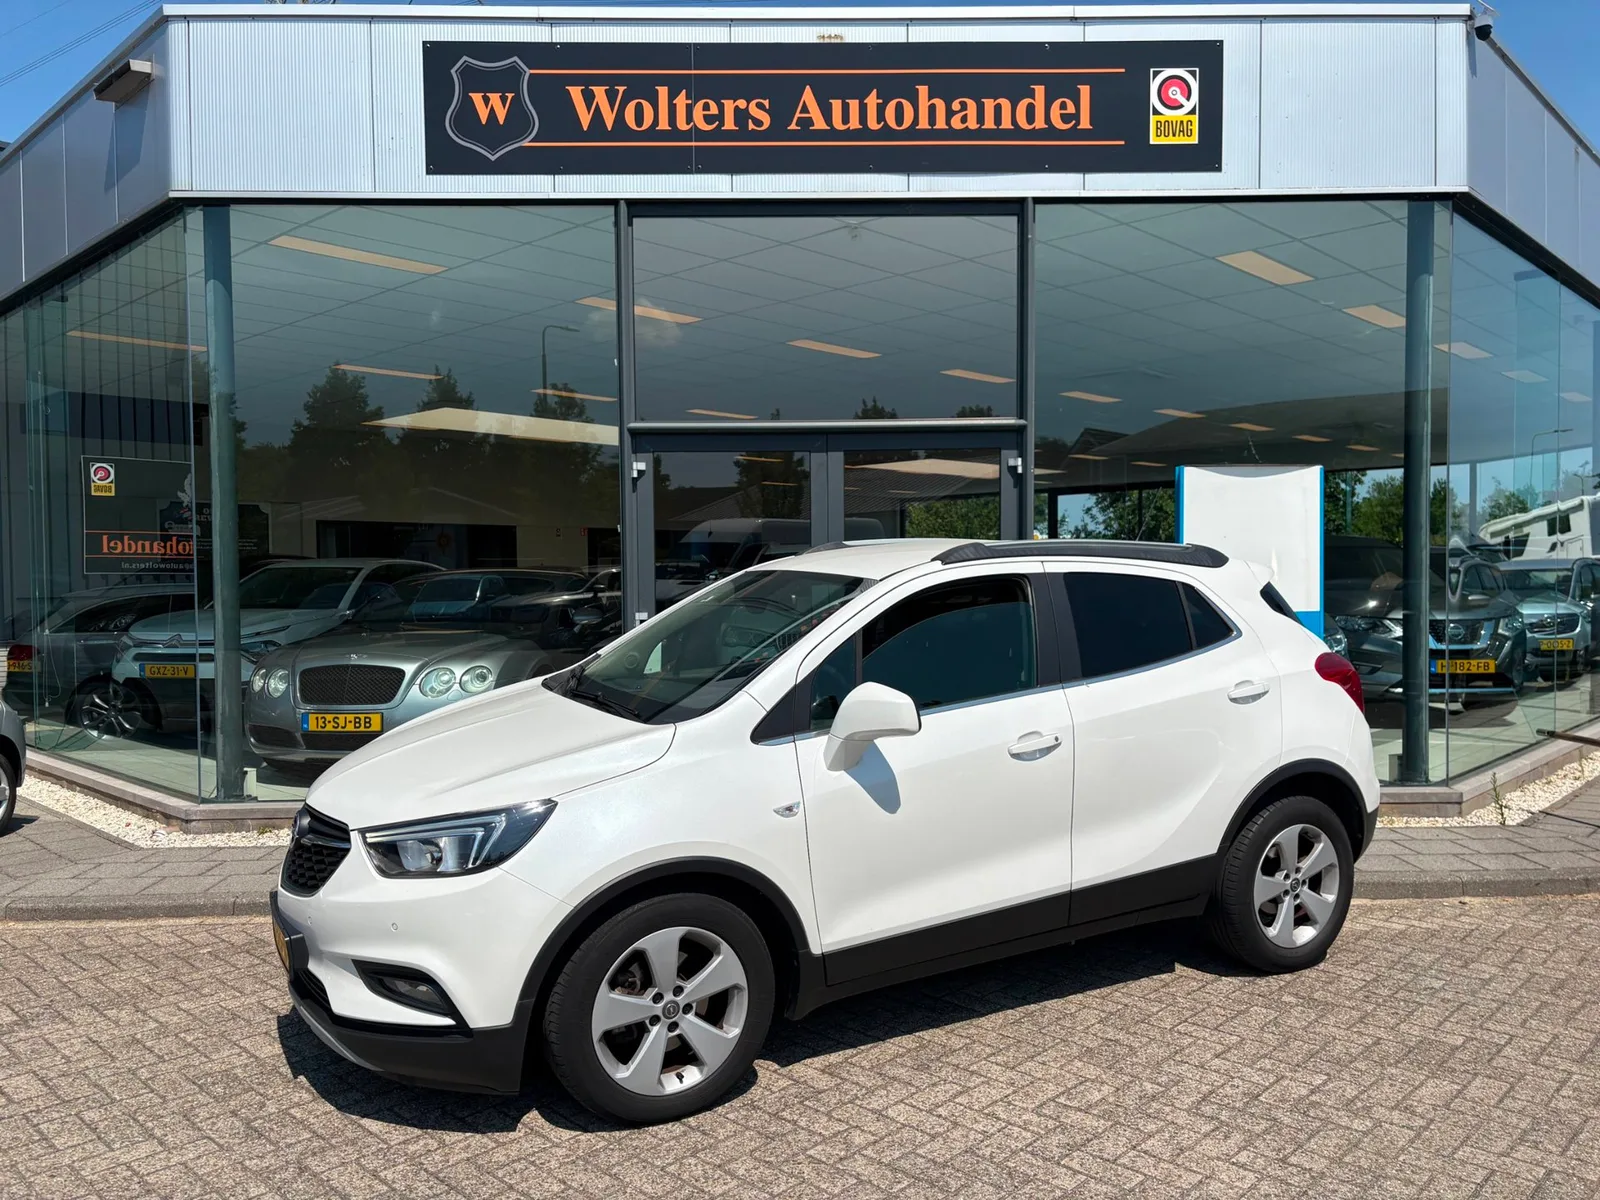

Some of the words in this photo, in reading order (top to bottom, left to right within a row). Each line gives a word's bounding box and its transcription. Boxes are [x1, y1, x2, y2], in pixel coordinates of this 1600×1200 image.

[469, 92, 514, 124] W
[567, 84, 771, 132] Wolters
[788, 83, 1093, 132] Autohandel
[1155, 119, 1194, 138] BOVAG
[149, 665, 189, 676] GXZ-31-V
[314, 716, 373, 730] 13-SJ-BB
